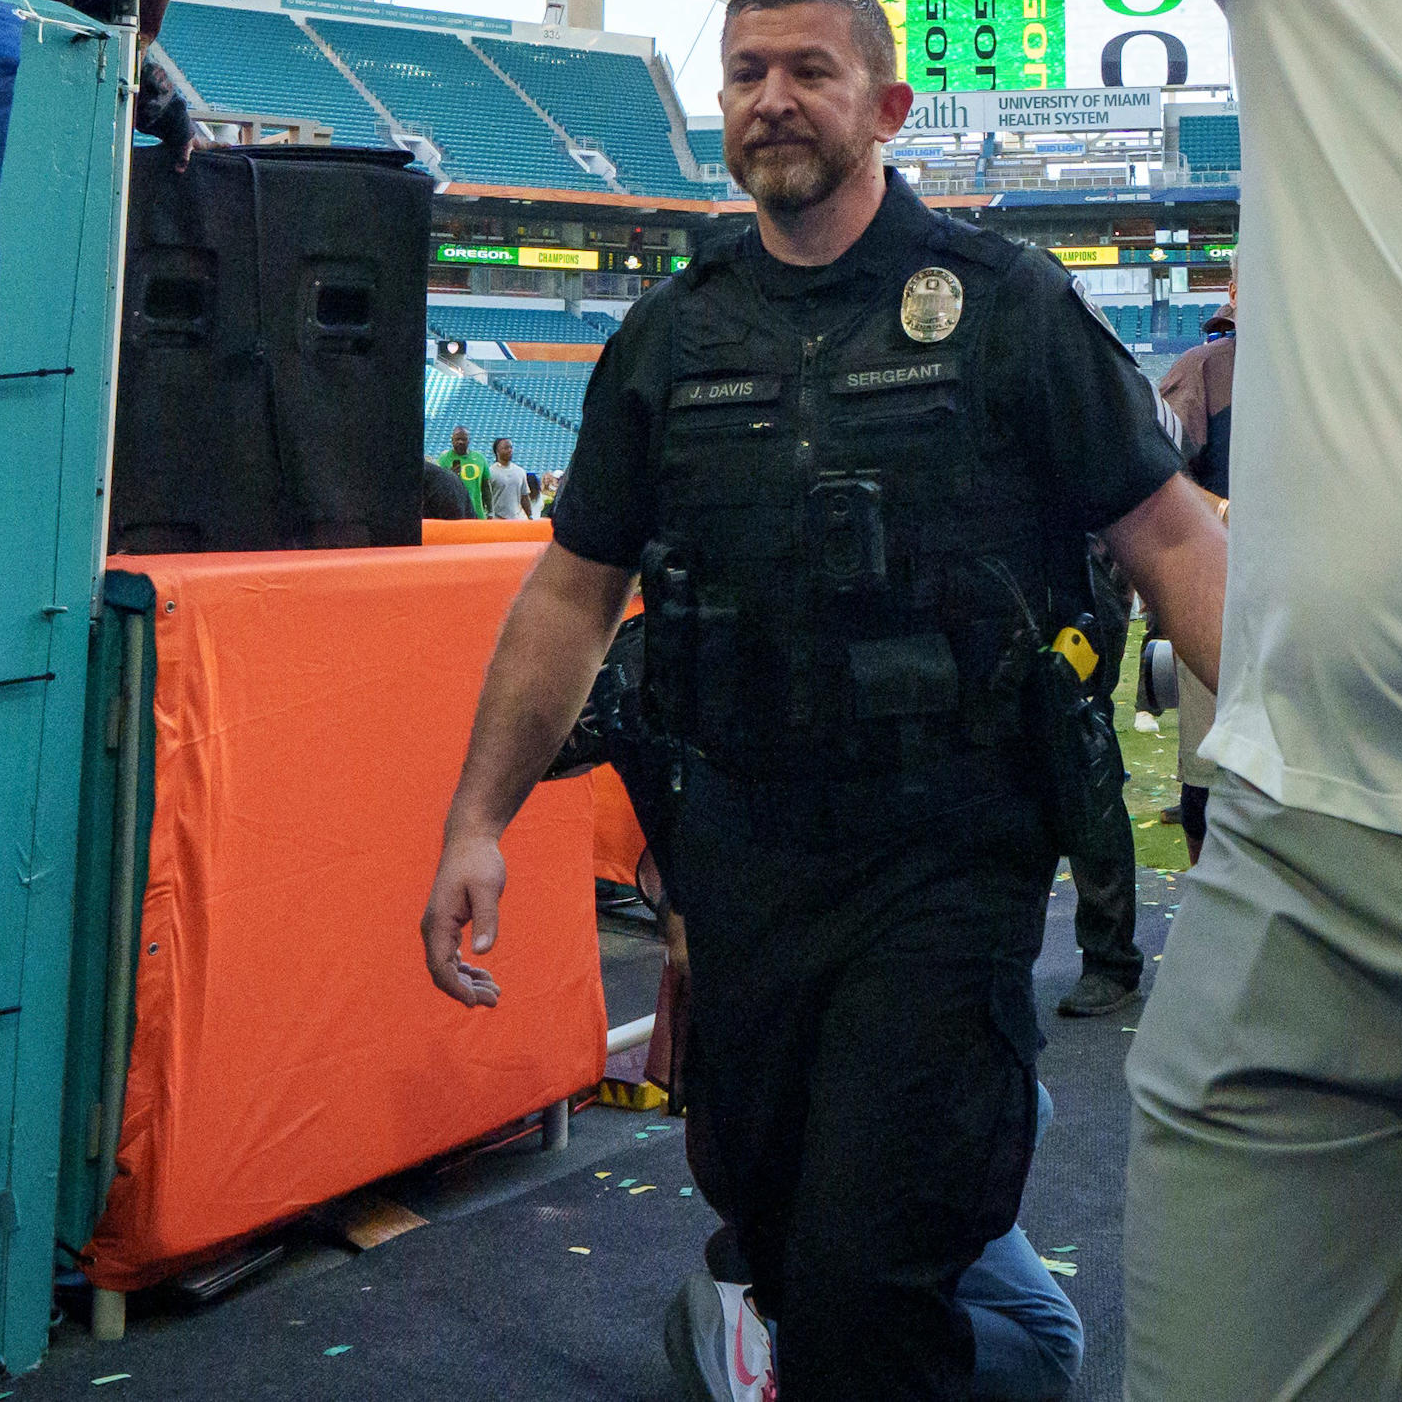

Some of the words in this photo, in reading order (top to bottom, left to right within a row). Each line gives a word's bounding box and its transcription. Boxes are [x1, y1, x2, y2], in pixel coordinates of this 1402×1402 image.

[543, 29, 561, 40] 336
[998, 94, 1081, 110] UNIVERSITY
[1083, 94, 1100, 108] OF
[1103, 93, 1151, 107] MIAMI
[998, 113, 1052, 127] HEALTH
[1054, 111, 1109, 125] SYSTEM
[914, 149, 942, 157] LIGHT
[1057, 144, 1084, 152] LIGHT
[538, 252, 580, 265] CHAMPIONS
[847, 363, 942, 387] SERGEANT
[689, 386, 702, 399] J.
[709, 381, 754, 398] DAVIS
[460, 463, 480, 481] O
